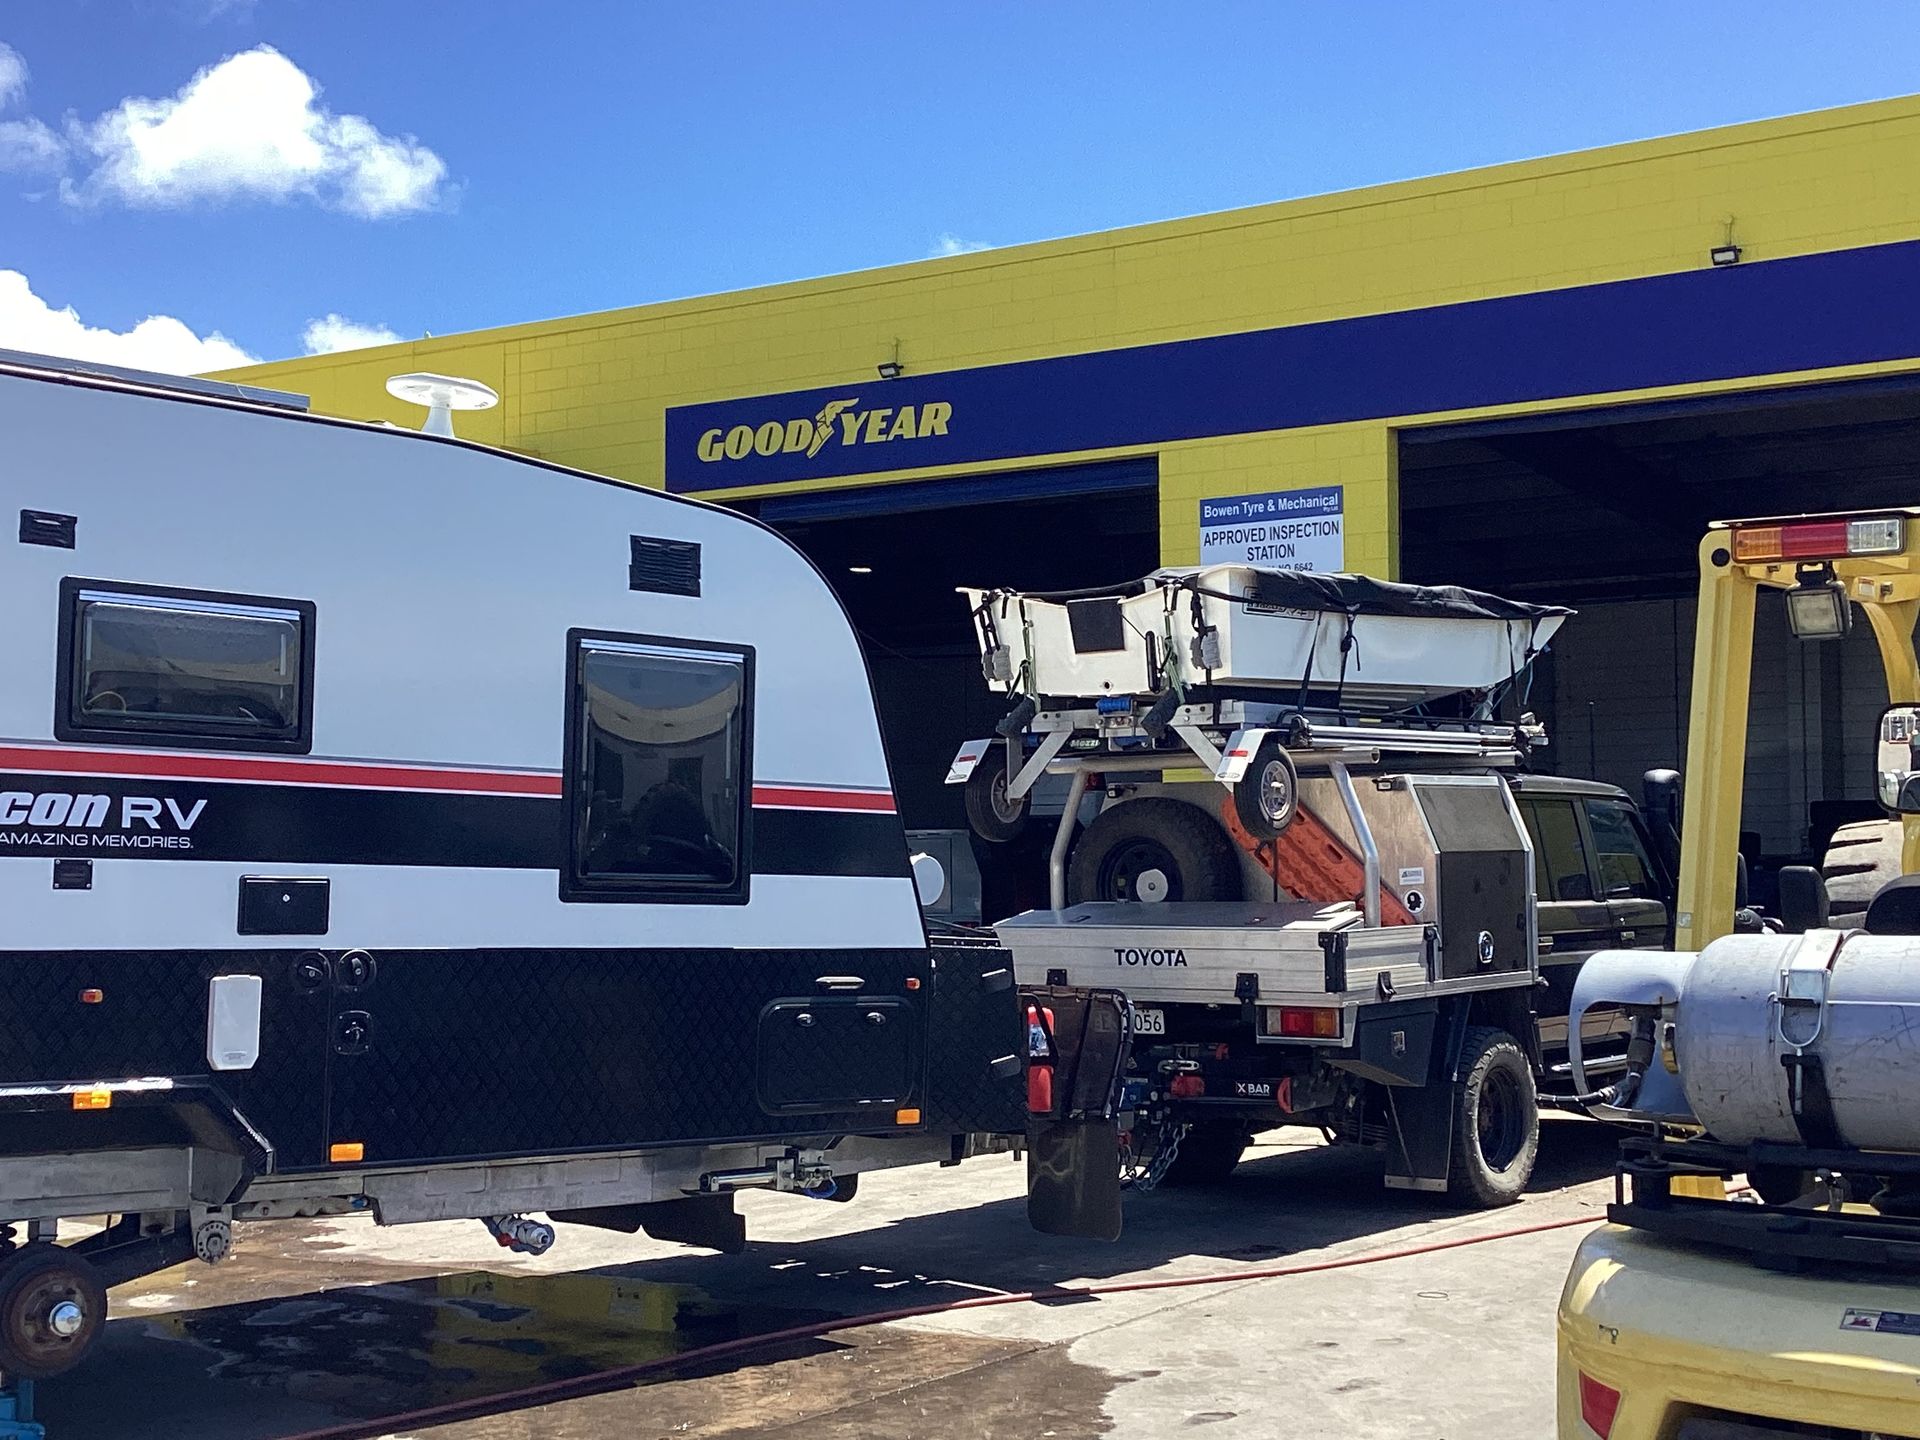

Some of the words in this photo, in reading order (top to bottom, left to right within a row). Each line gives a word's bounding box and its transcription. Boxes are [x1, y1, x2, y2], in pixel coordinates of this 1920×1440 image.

[696, 398, 952, 462] GOODYEAR
[1204, 505, 1239, 518] Bowen
[1242, 501, 1264, 517] Tyre
[1267, 499, 1275, 512] &
[1278, 493, 1338, 510] Mechanical
[1204, 528, 1266, 546] APPROVED
[1270, 521, 1339, 540] INSPECTION
[1247, 543, 1295, 561] STATION
[121, 796, 208, 831] RV
[0, 832, 88, 846] AMAZING
[1114, 948, 1187, 967] TOYOTA
[1237, 1082, 1246, 1094] X
[1247, 1083, 1270, 1094] BAR
